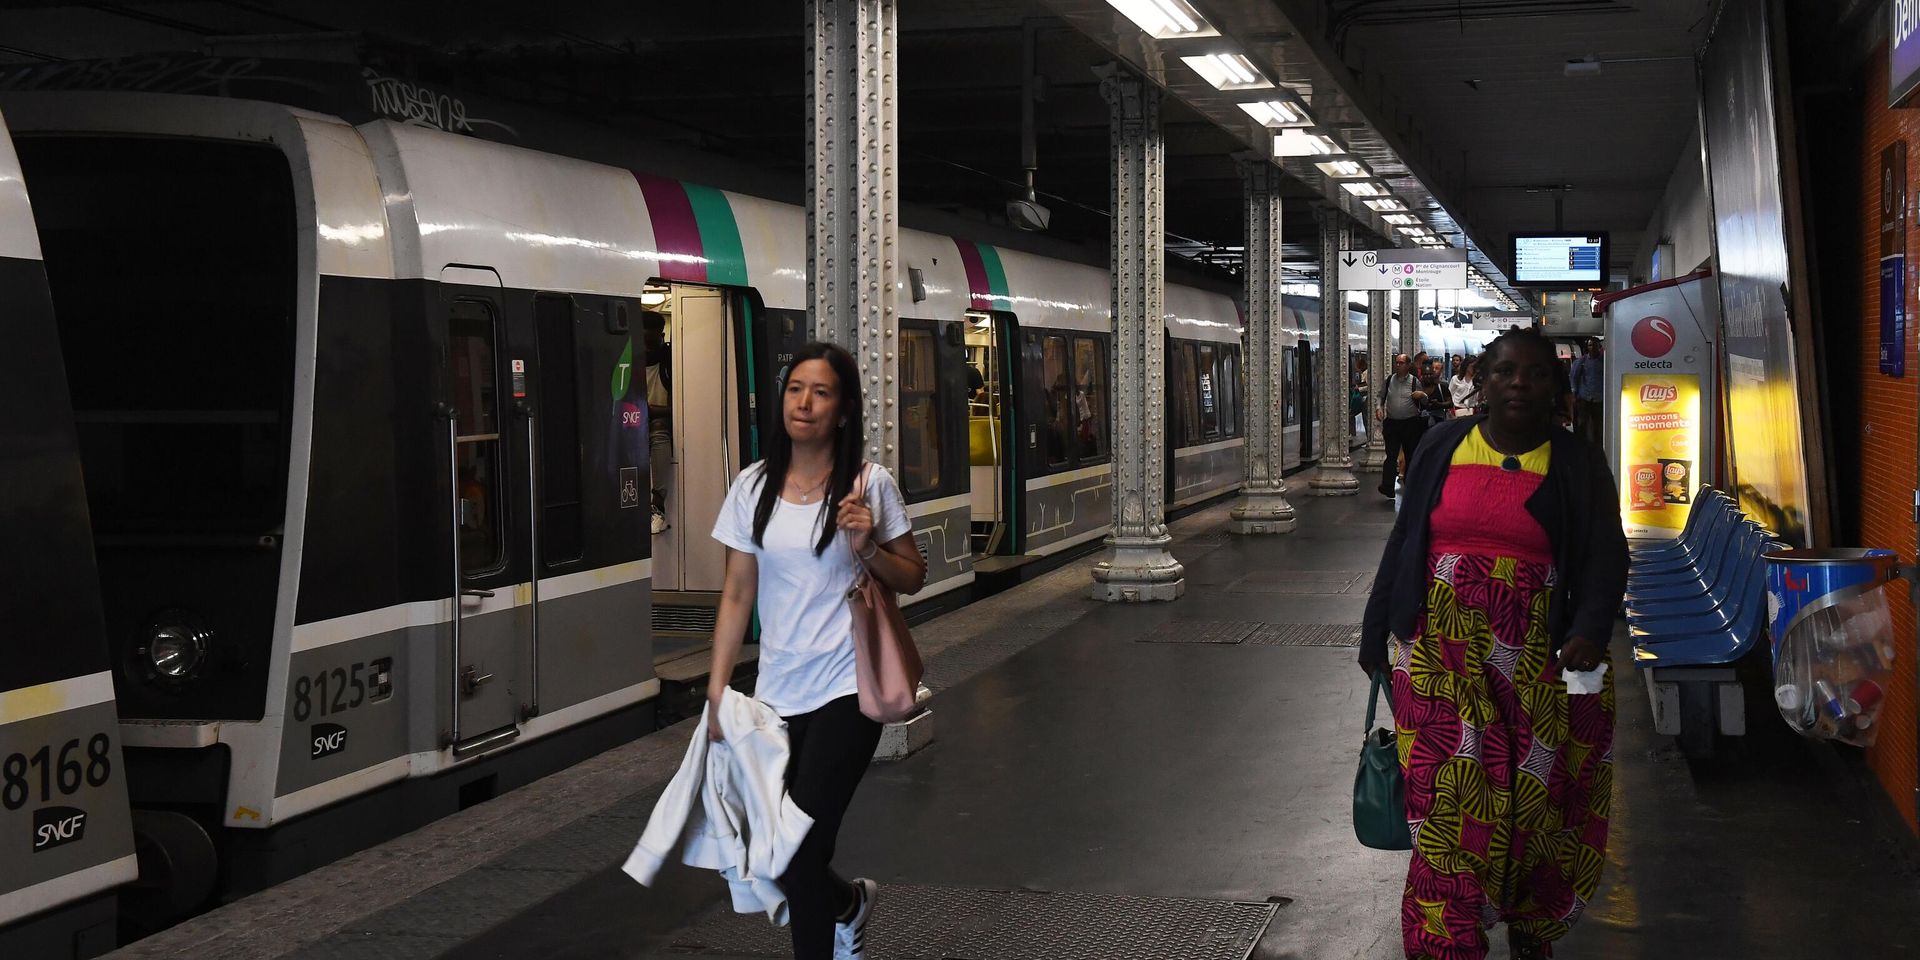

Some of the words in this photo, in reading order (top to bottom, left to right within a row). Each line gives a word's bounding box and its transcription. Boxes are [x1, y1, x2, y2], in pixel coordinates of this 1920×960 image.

[777, 353, 794, 362] RATP
[1634, 359, 1673, 369] selecta
[618, 363, 631, 391] T
[622, 410, 641, 425] SNCF
[293, 662, 365, 722] 8125
[312, 730, 347, 756] SNCF
[2, 732, 111, 811] 8168
[34, 813, 86, 848] SNCF
